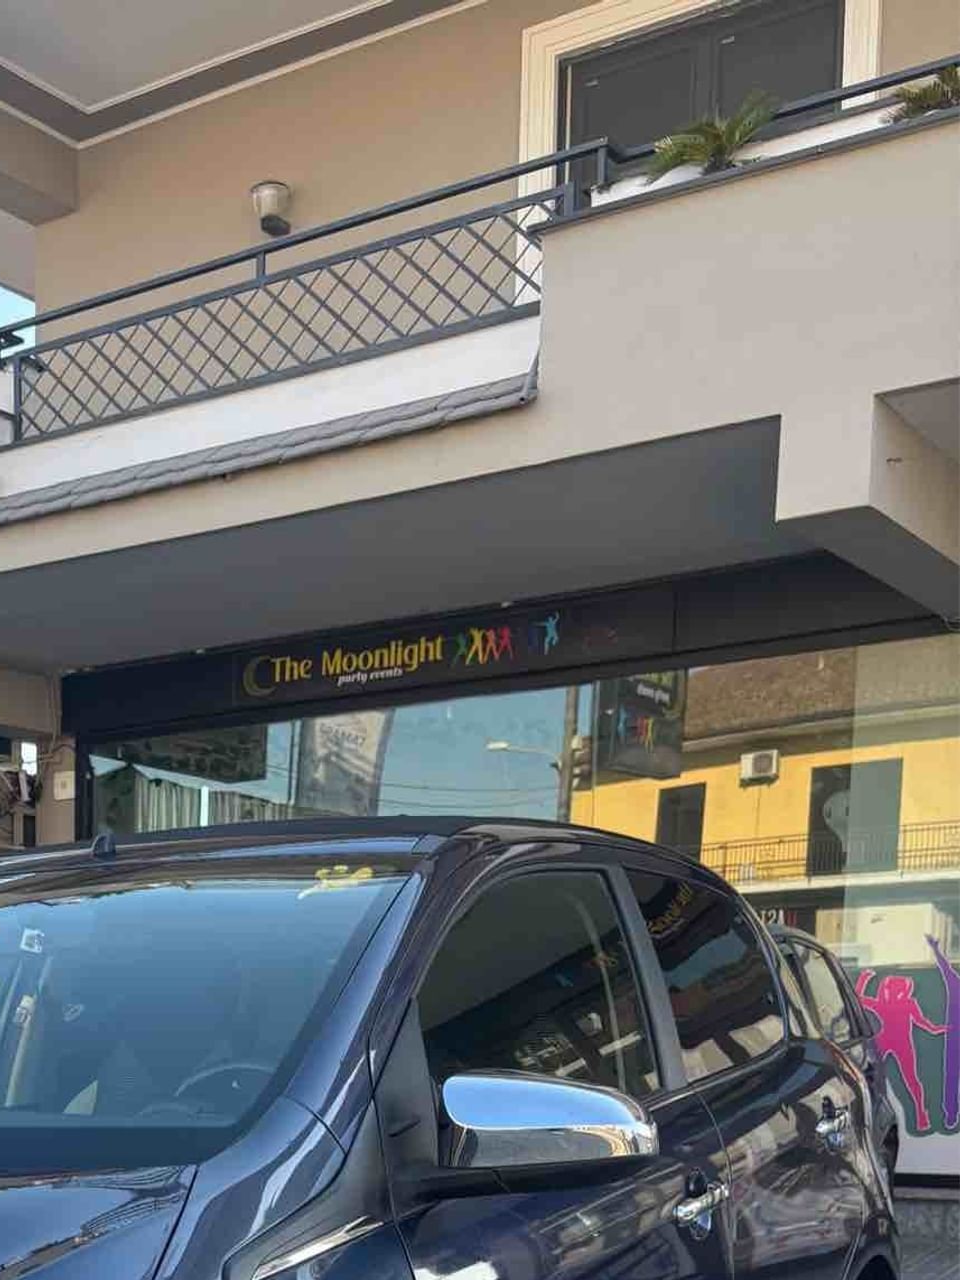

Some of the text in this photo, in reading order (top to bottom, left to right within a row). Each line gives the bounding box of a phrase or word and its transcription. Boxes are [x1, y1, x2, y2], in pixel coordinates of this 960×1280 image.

[271, 635, 444, 682] The Moonlight
[337, 667, 404, 686] party events
